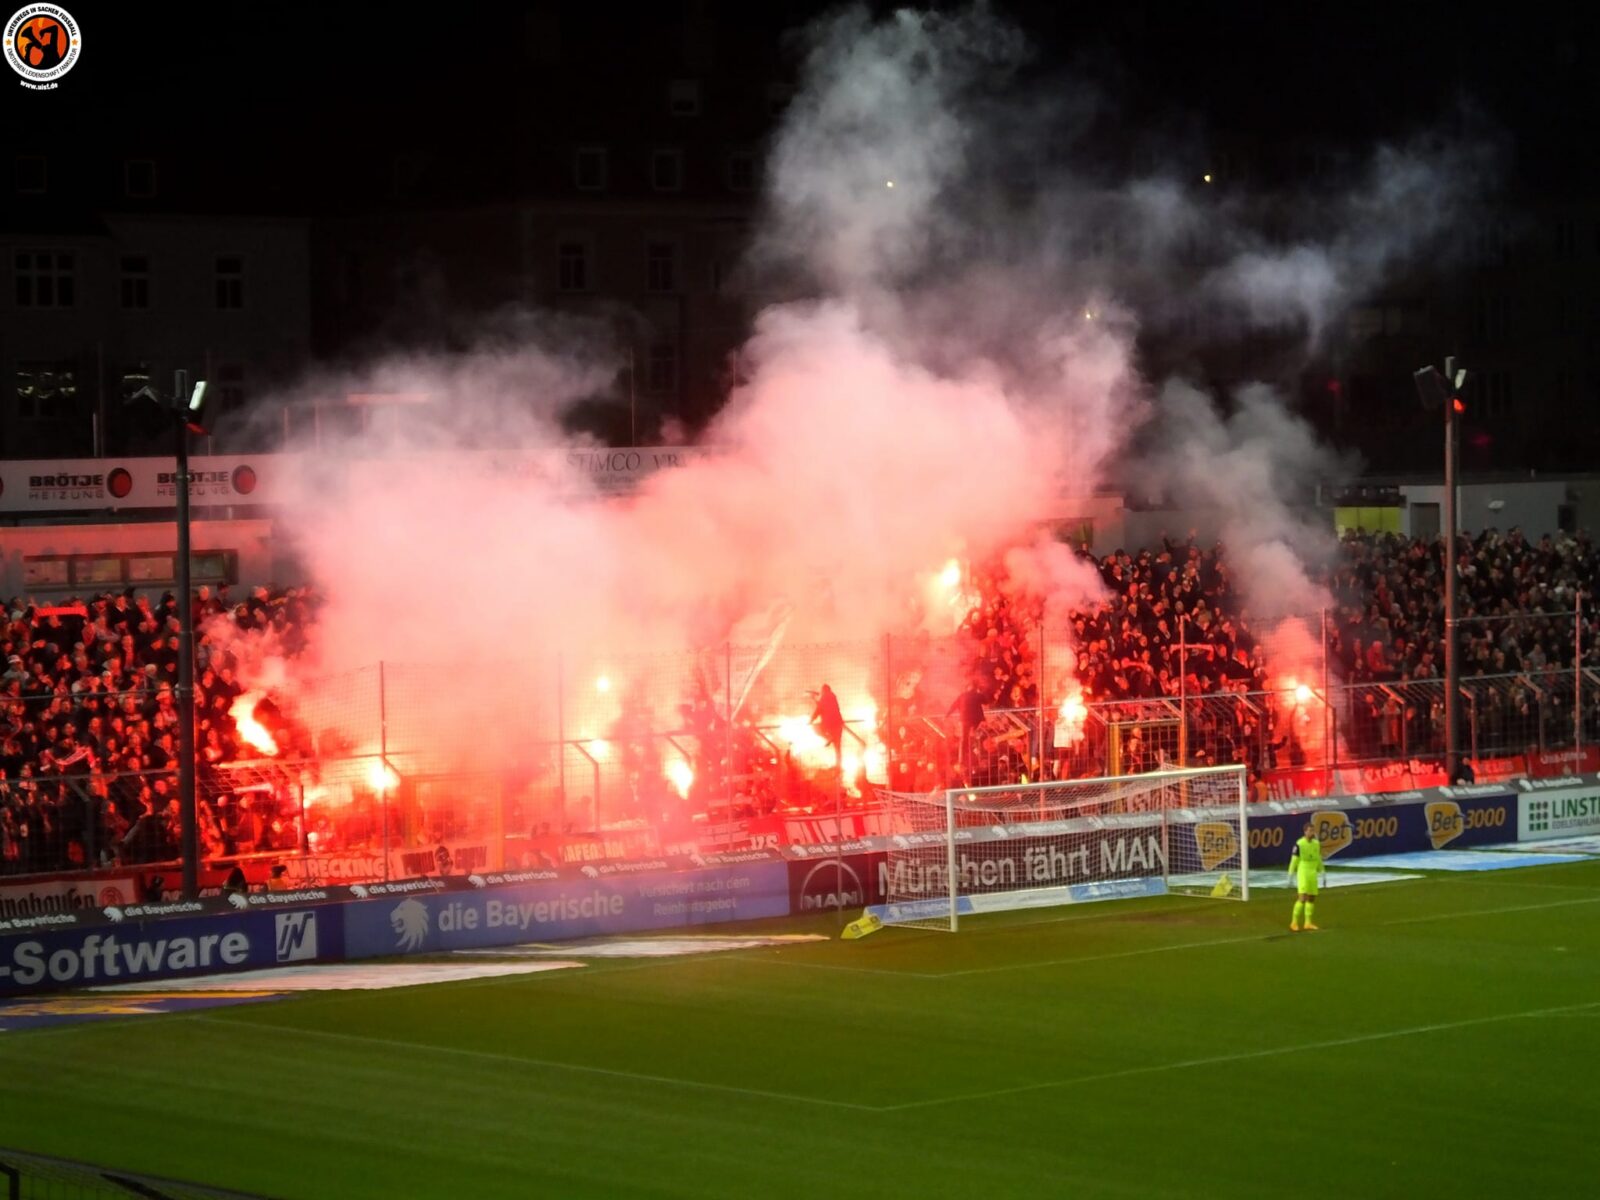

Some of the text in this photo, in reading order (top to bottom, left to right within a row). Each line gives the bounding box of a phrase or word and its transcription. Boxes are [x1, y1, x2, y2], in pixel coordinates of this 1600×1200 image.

[29, 473, 104, 488] BRÖTJE
[29, 490, 105, 501] HEIZUNG
[157, 487, 230, 498] HEZUNG
[1432, 807, 1506, 831] Bet 3000
[1318, 817, 1398, 841] Bet 3000
[1246, 827, 1283, 848] 000
[1024, 845, 1090, 881] fährt
[1100, 834, 1167, 872] MAN
[286, 858, 386, 880] WRECKING
[487, 872, 558, 885] die Bayerische
[699, 880, 724, 892] nach
[727, 876, 749, 890] dem
[369, 880, 445, 896] die Bayerische
[249, 889, 327, 905] die Bayerische
[804, 892, 857, 909] MAN
[125, 901, 202, 917] die Bayerische
[438, 890, 623, 931] die Bayerische
[12, 914, 76, 927] Bayerische
[0, 932, 249, 985] -Software
